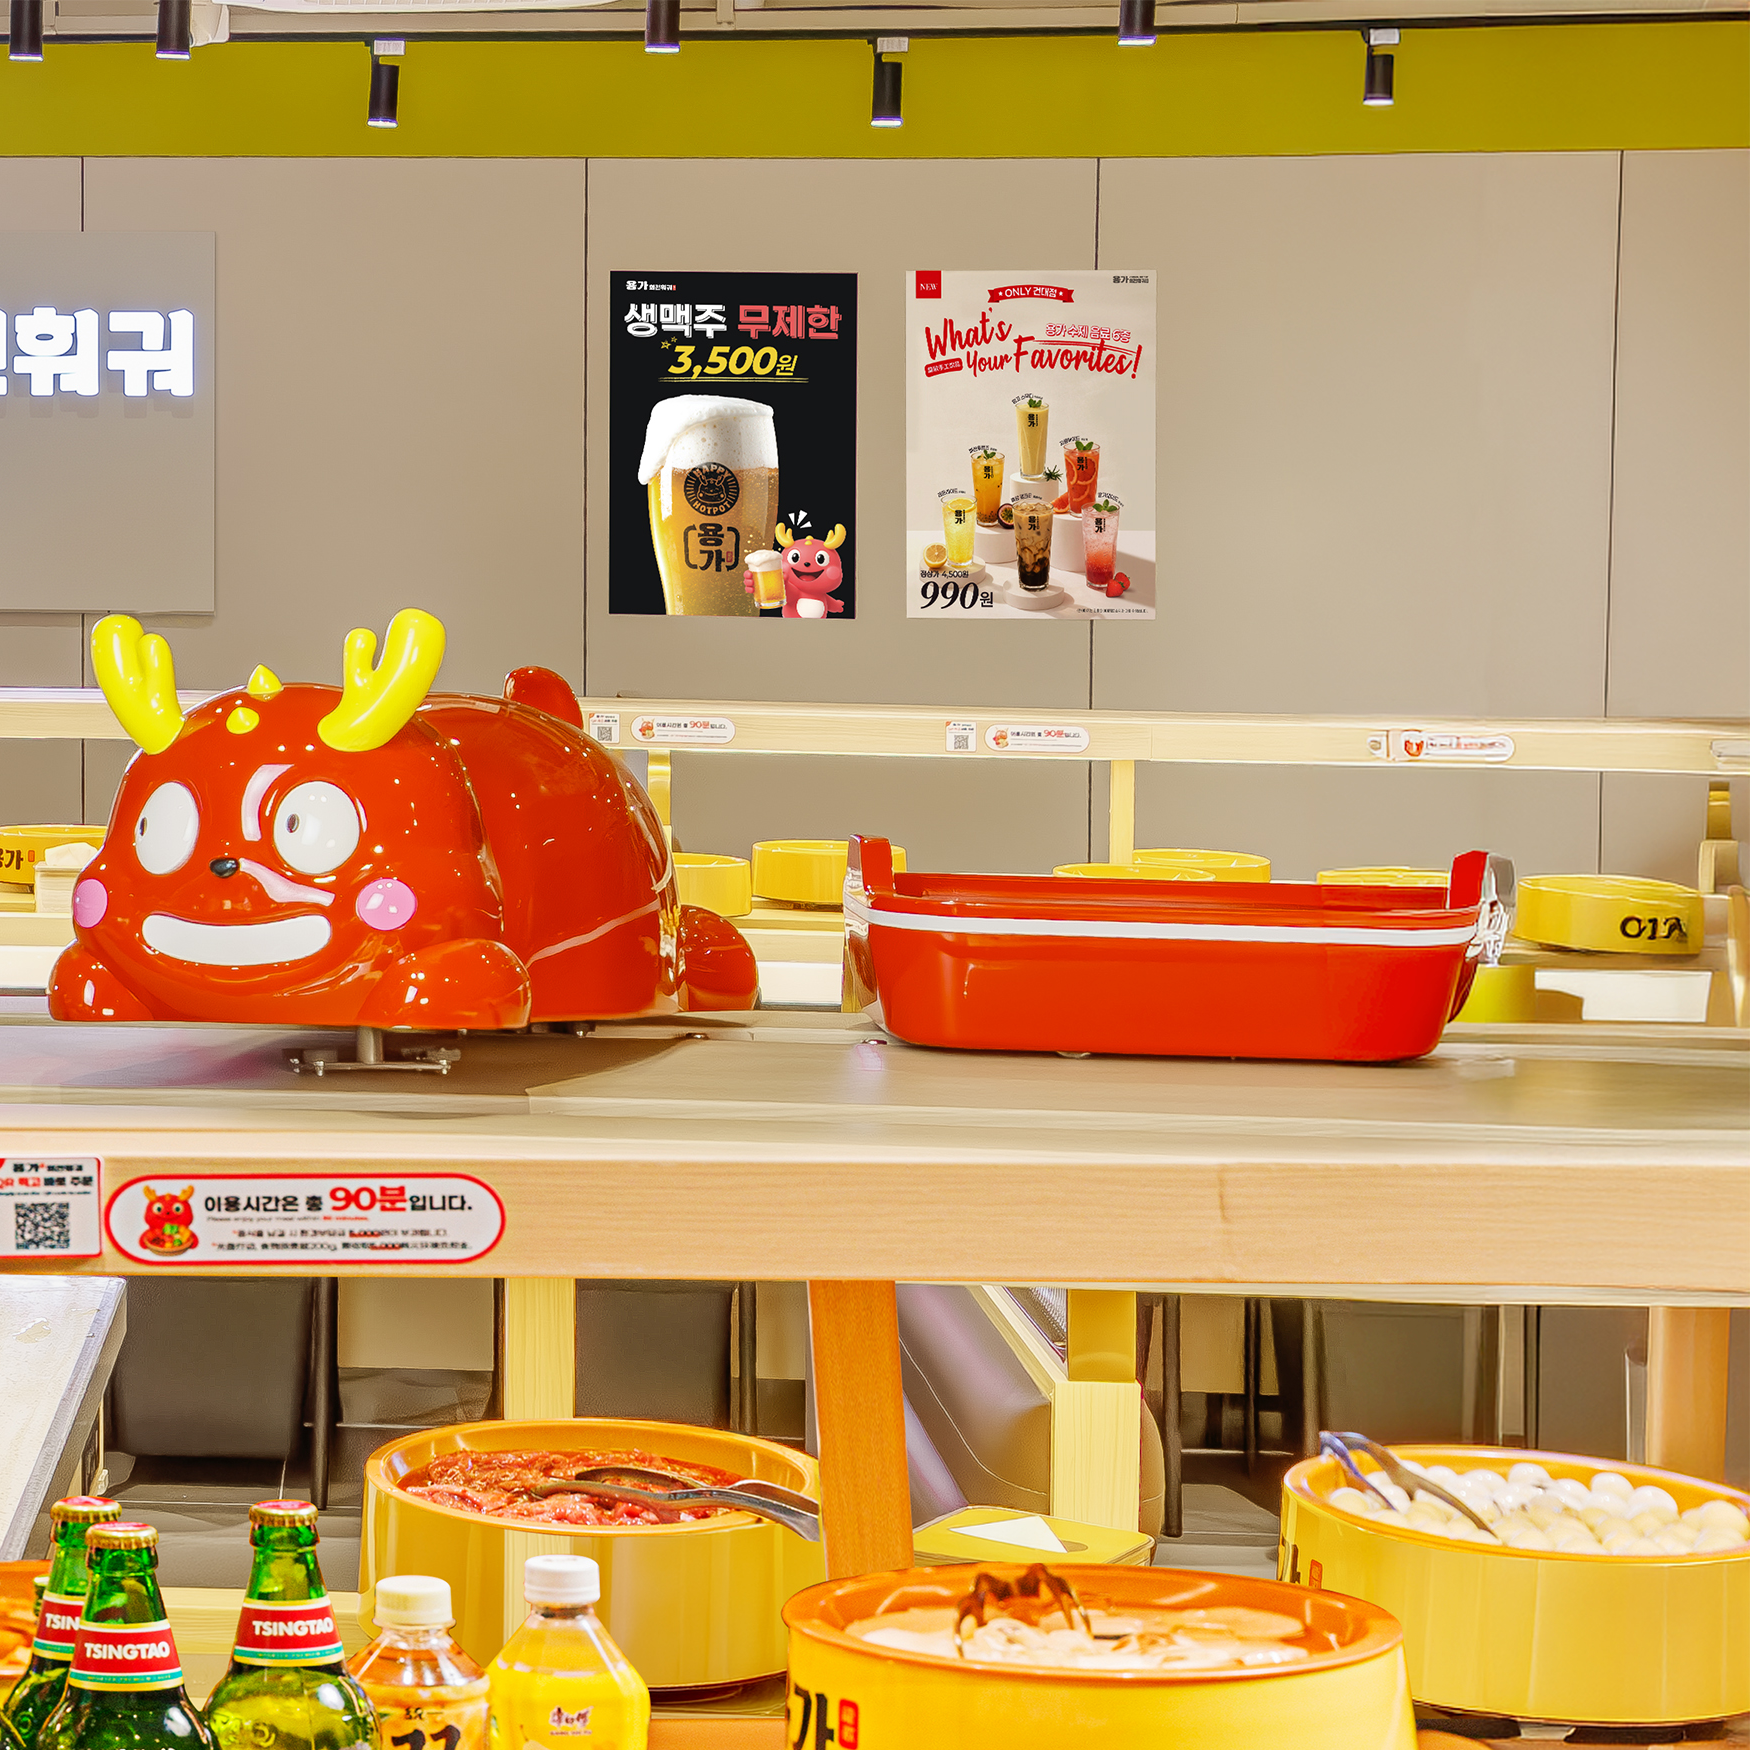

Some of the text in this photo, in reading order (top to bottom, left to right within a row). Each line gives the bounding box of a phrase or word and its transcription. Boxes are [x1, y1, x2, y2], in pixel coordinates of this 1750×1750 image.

[625, 280, 649, 291] 용가
[920, 283, 938, 291] NEW
[1004, 287, 1031, 298] ONLY
[624, 303, 842, 340] 생맥주 무제한
[925, 307, 1012, 360] What's
[667, 345, 798, 379] 3,500원
[967, 335, 1142, 379] Your Favorites!
[693, 463, 731, 478] HAPPY
[692, 500, 732, 515] HOTPOT
[697, 522, 726, 572] 용가
[941, 570, 969, 579] 4,500원
[920, 580, 994, 610] 990원
[204, 1195, 299, 1212] 이용시간은
[45, 1613, 80, 1631] TSIN
[252, 1617, 334, 1636] TSINGTAO
[84, 1641, 170, 1660] TSINGTAO
